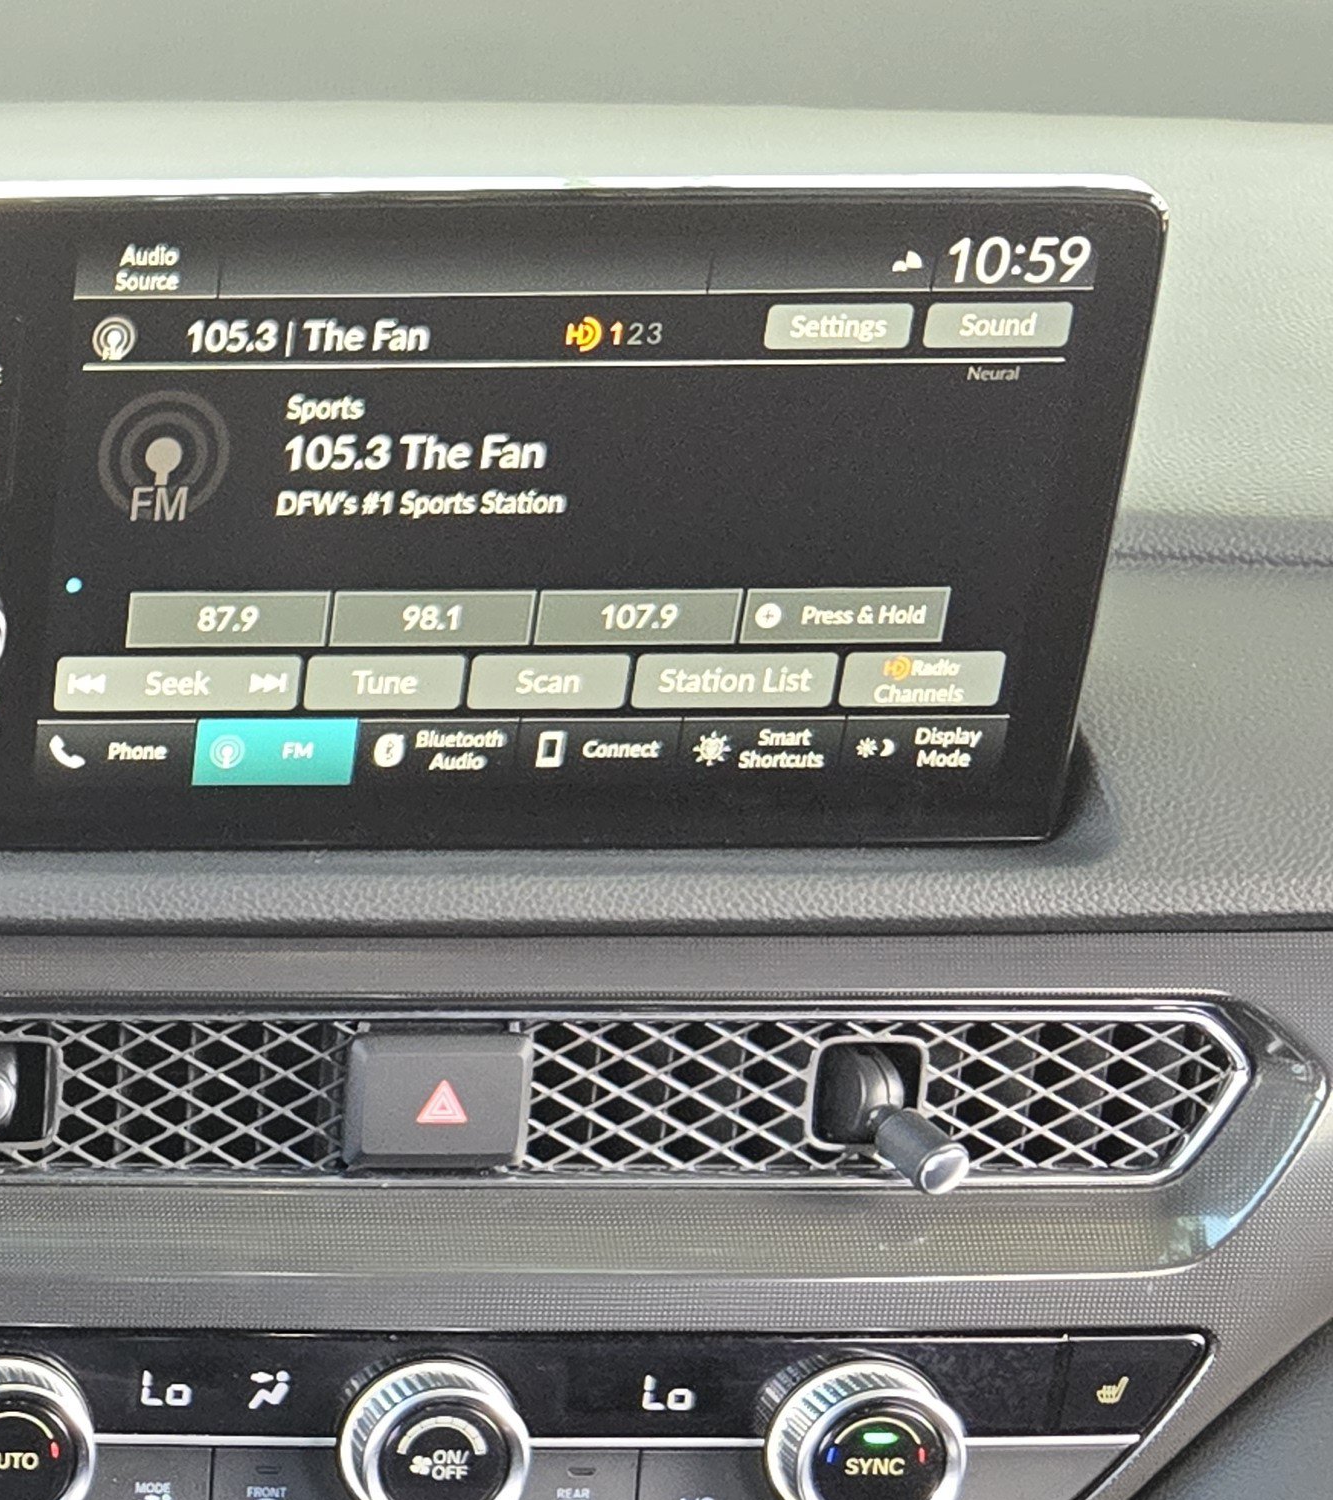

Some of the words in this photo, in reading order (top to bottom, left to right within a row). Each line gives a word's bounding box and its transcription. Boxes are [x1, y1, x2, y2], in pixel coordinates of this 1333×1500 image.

[120, 246, 178, 267] Audio
[947, 236, 1091, 284] 10:59
[115, 273, 178, 290] Source
[186, 320, 278, 352] 105.3
[302, 320, 366, 352] The
[373, 320, 430, 352] Fan
[789, 315, 887, 341] Settings
[959, 314, 1036, 337] Sound
[966, 365, 1020, 381] Neural
[286, 395, 364, 423] Sports
[283, 435, 390, 471] 105.3
[399, 435, 473, 470] The
[480, 435, 546, 470] Fan
[130, 487, 189, 522] FM
[276, 491, 358, 516] DFW's
[361, 491, 393, 516] #1
[399, 491, 476, 519] Sports
[481, 490, 566, 515] Station
[198, 607, 259, 631] 87.9
[402, 606, 461, 630] 98.1
[599, 604, 678, 628] 107.9
[801, 605, 853, 626] Press
[856, 605, 874, 624] &
[878, 605, 926, 625] Hold
[910, 660, 960, 677] Radio
[145, 672, 211, 696] Seek
[352, 671, 418, 695] Tune
[516, 670, 581, 694] Scan
[658, 668, 754, 693] Station
[762, 668, 812, 692] List
[873, 684, 963, 704] Channels
[415, 730, 505, 749] Bluetooth
[757, 728, 811, 747] Smart
[914, 727, 982, 749] Display
[108, 742, 167, 761] Phone
[282, 742, 313, 759] FM
[582, 739, 660, 759] Connect
[738, 750, 825, 769] Shortcuts
[916, 749, 971, 768] Mode
[429, 752, 485, 771] Audio
[433, 1449, 469, 1467] ON/
[845, 1456, 904, 1477] SYNC
[432, 1465, 469, 1481] OFF
[134, 1482, 171, 1494] MODE
[247, 1487, 287, 1499] FRONT
[557, 1488, 590, 1500] REAR
